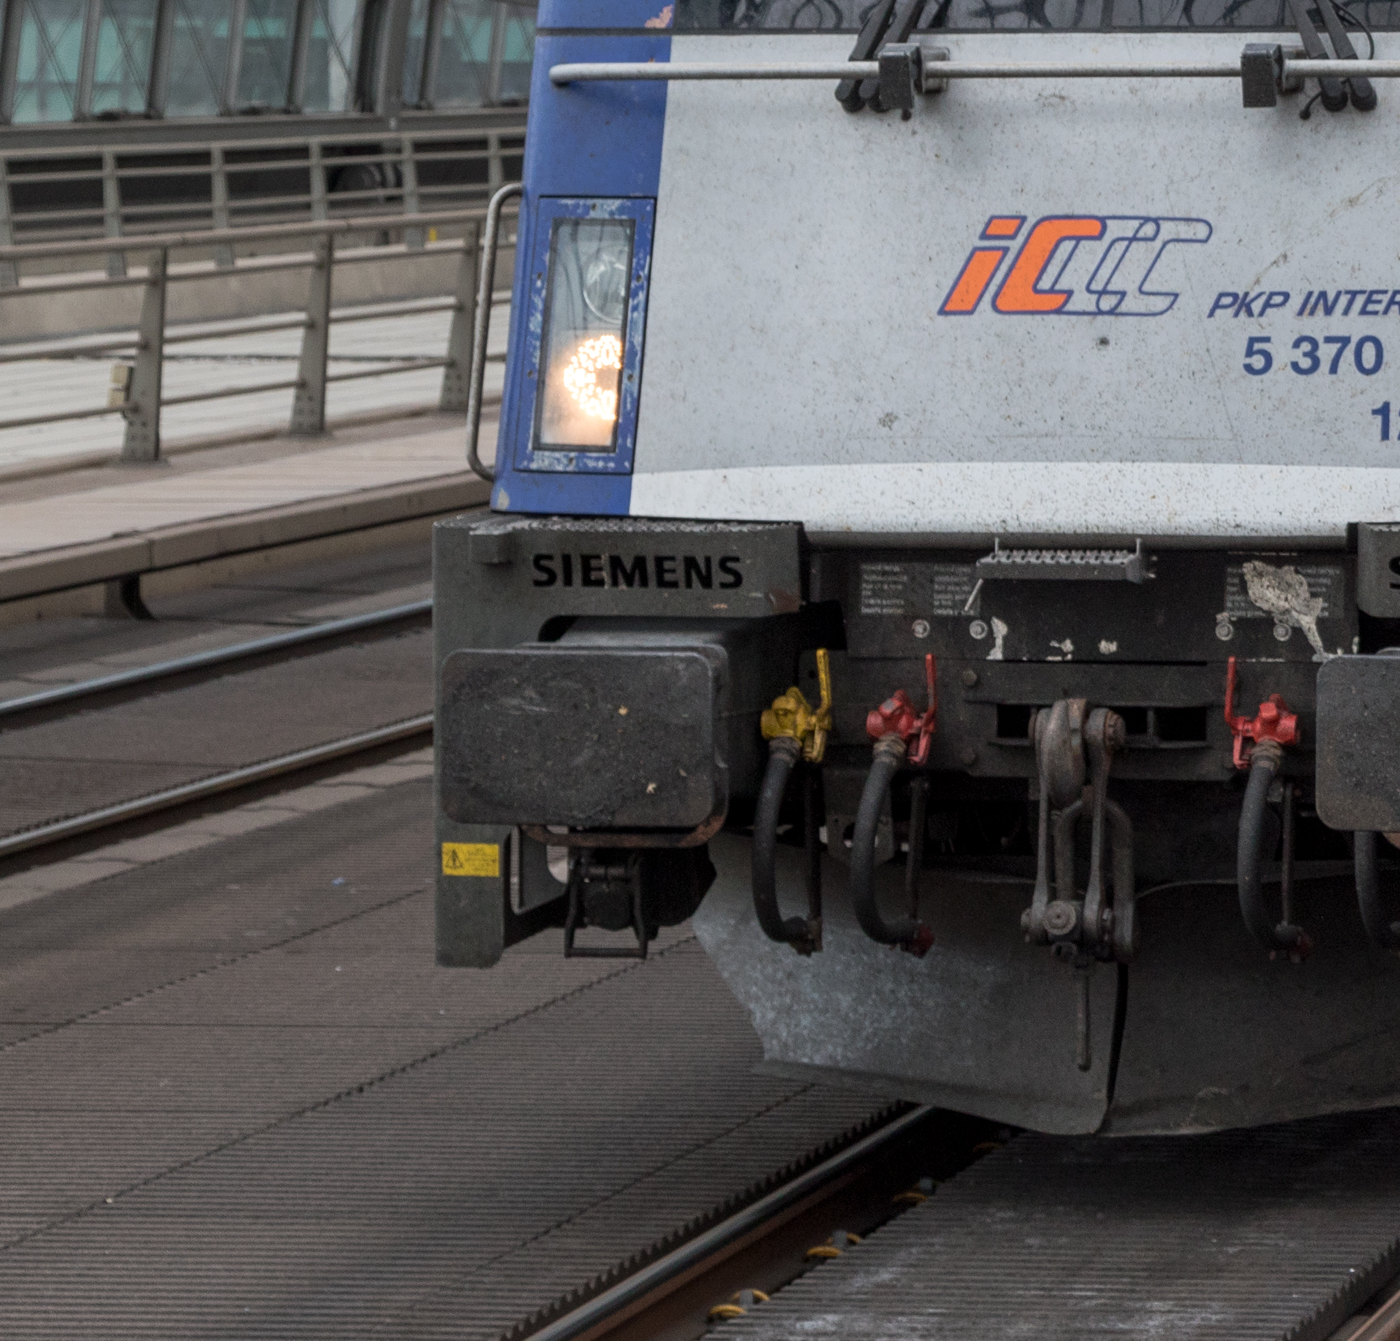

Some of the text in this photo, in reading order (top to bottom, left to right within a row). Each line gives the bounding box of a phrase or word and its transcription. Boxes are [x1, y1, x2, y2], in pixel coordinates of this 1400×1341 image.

[1208, 291, 1290, 318] PKP
[1243, 337, 1273, 374] 5
[1290, 336, 1385, 375] 370
[532, 553, 744, 589] SIEMENS
